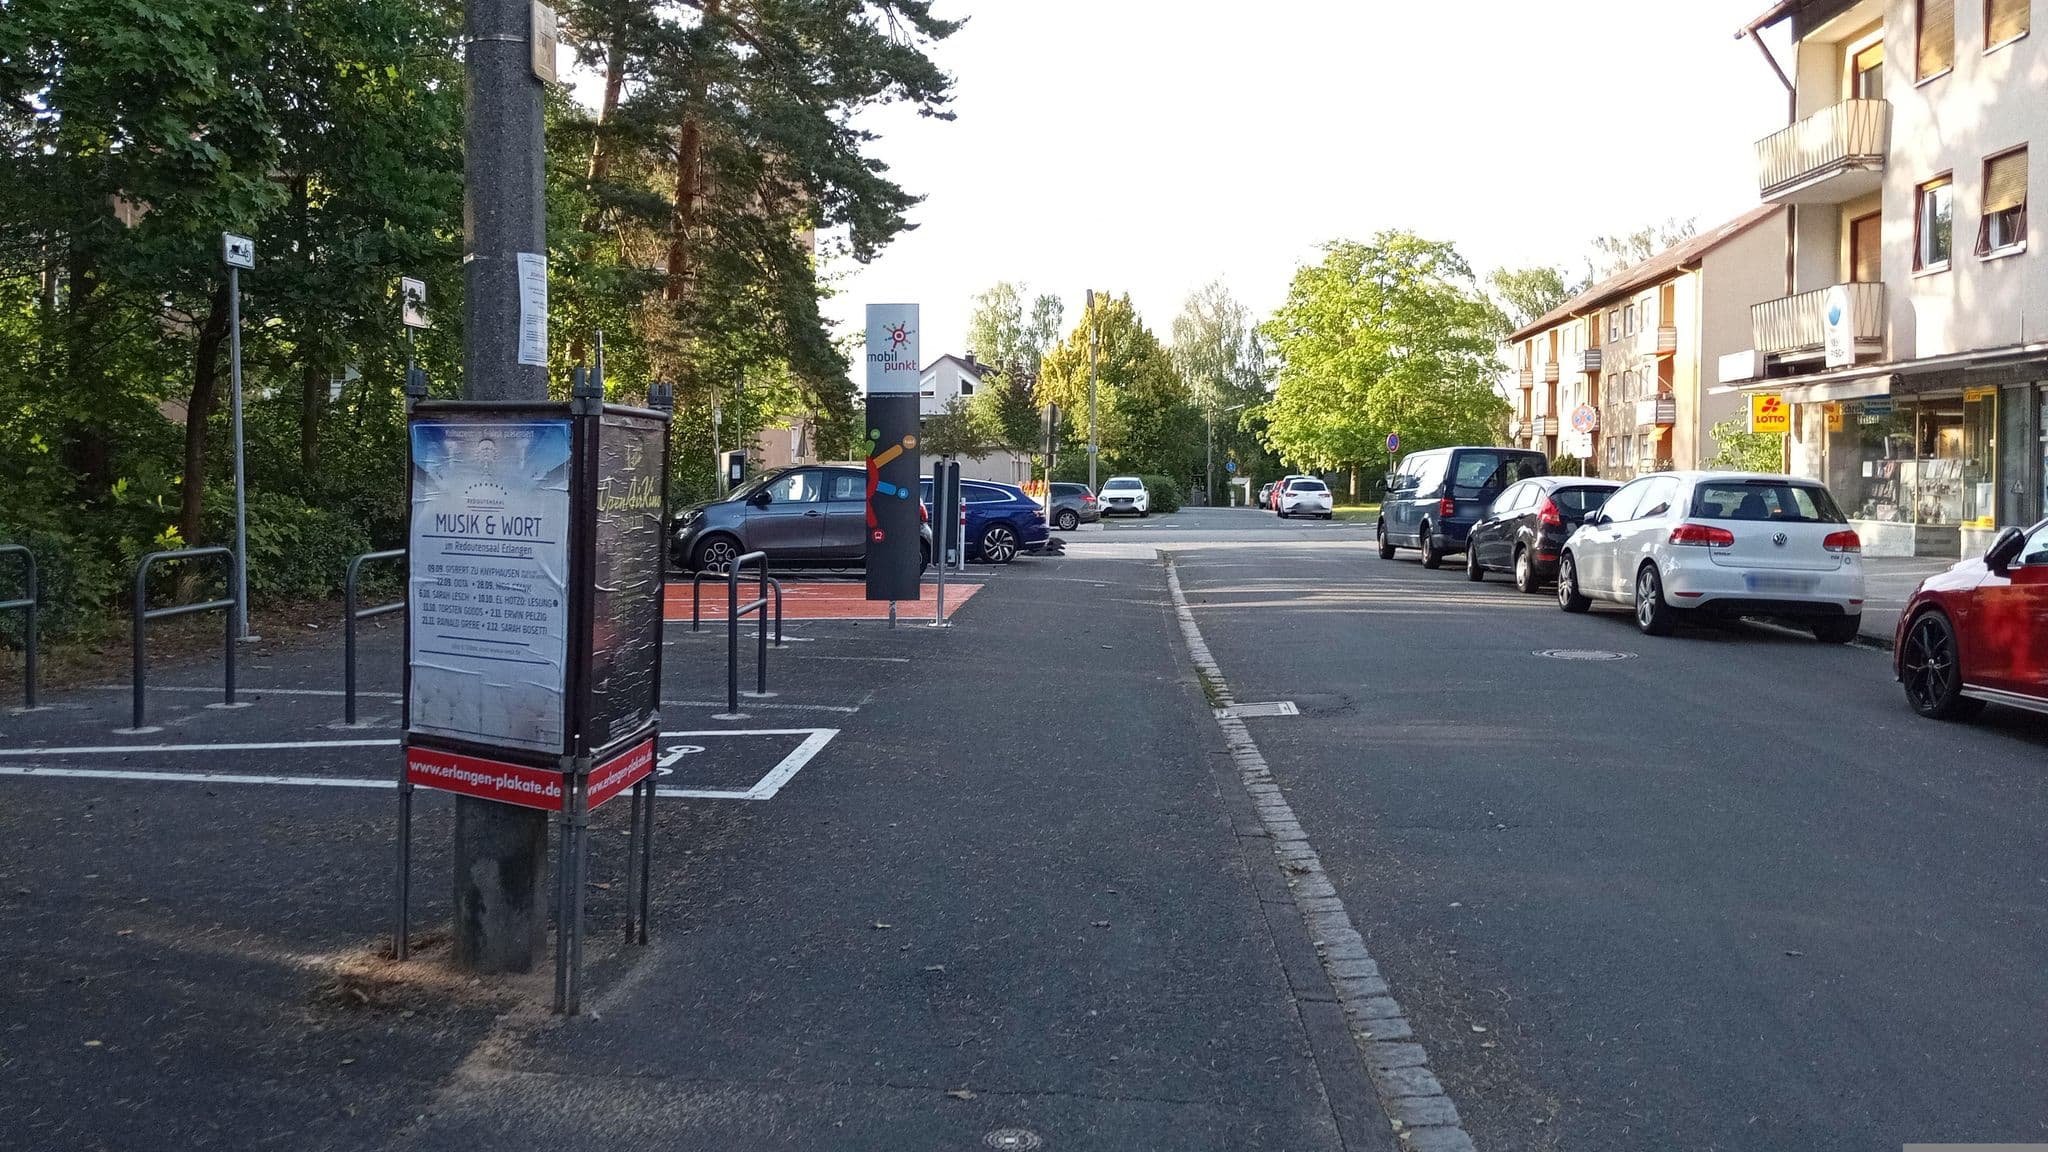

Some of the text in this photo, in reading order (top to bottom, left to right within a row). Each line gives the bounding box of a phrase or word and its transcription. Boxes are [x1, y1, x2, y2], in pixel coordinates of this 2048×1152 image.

[868, 351, 897, 362] mobil
[884, 360, 916, 373] punkt
[1756, 415, 1785, 424] LOTTO
[435, 513, 542, 537] MUSIK & WORT
[445, 541, 532, 557] im Redoutensaal Erlangen
[471, 566, 479, 576] ZU
[504, 609, 524, 620] ERWIN
[525, 611, 547, 622] PELZIG
[501, 623, 521, 633] SARAH
[409, 761, 561, 797] www.erlangen-plakate.de
